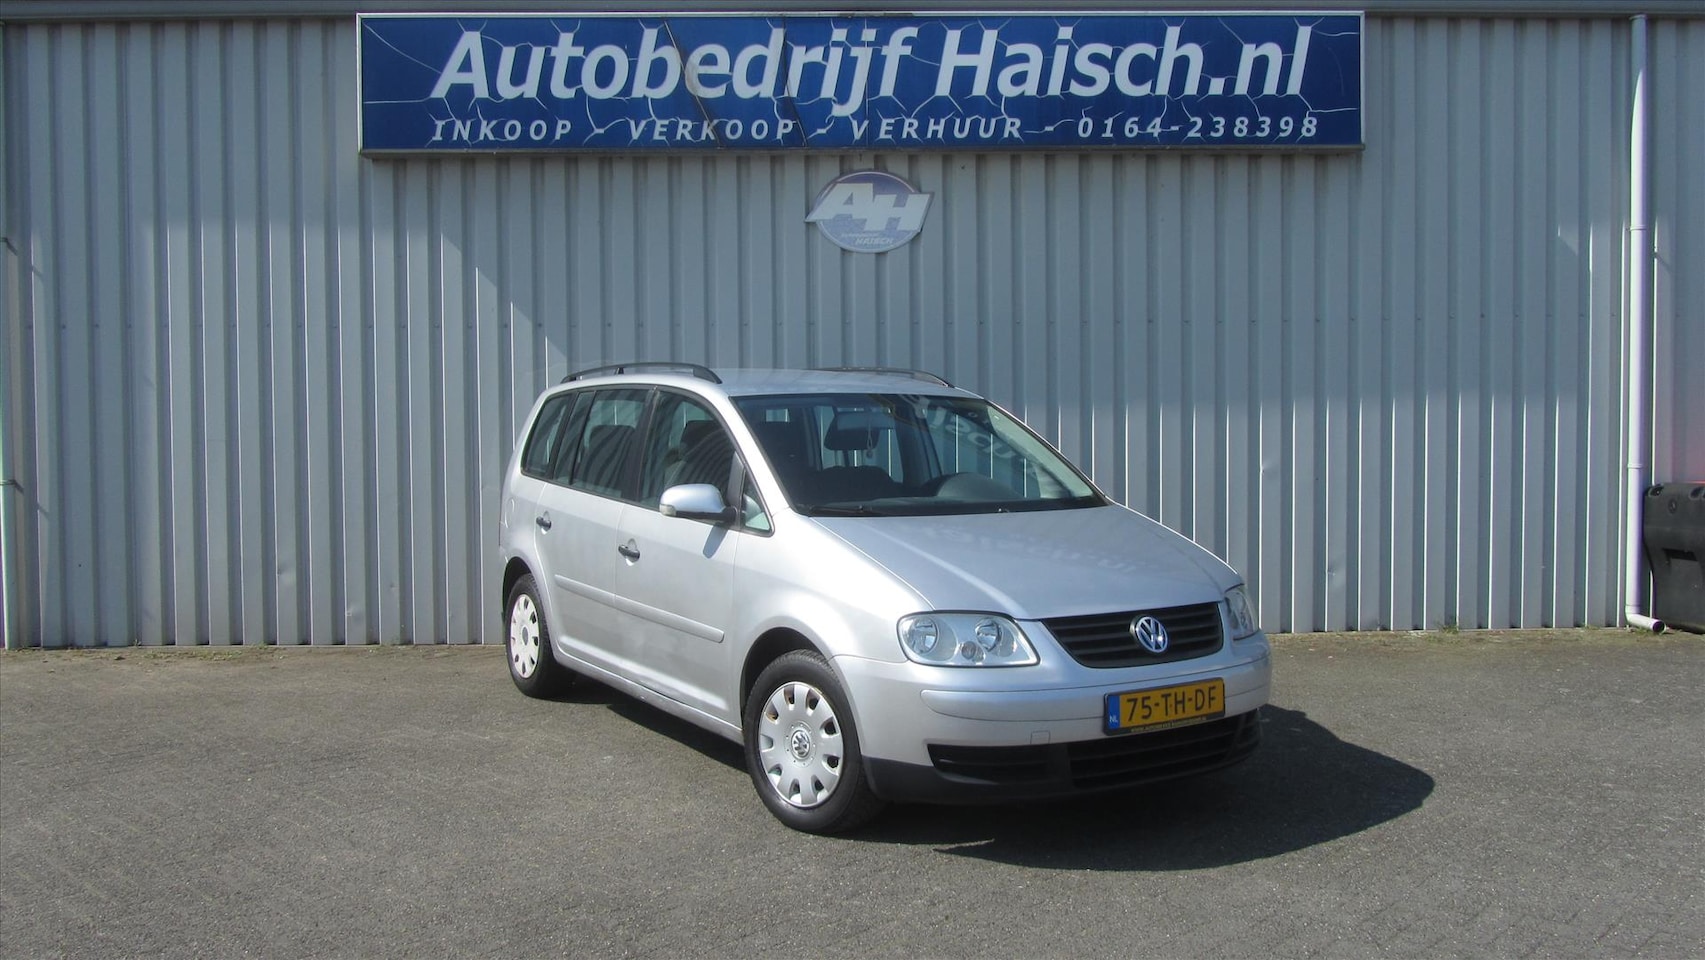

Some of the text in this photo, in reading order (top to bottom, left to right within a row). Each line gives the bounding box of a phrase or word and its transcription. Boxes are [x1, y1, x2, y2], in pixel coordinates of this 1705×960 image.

[431, 25, 1314, 116] Autobedrijf Haisch.nl
[434, 119, 573, 141] INKOOP
[630, 119, 794, 141] VERKOOP
[851, 118, 1021, 140] VERHUUR
[1078, 117, 1318, 139] 0164-238398
[805, 183, 930, 231] AH
[1109, 714, 1118, 723] NL
[1126, 686, 1217, 722] 75-TH-DF
